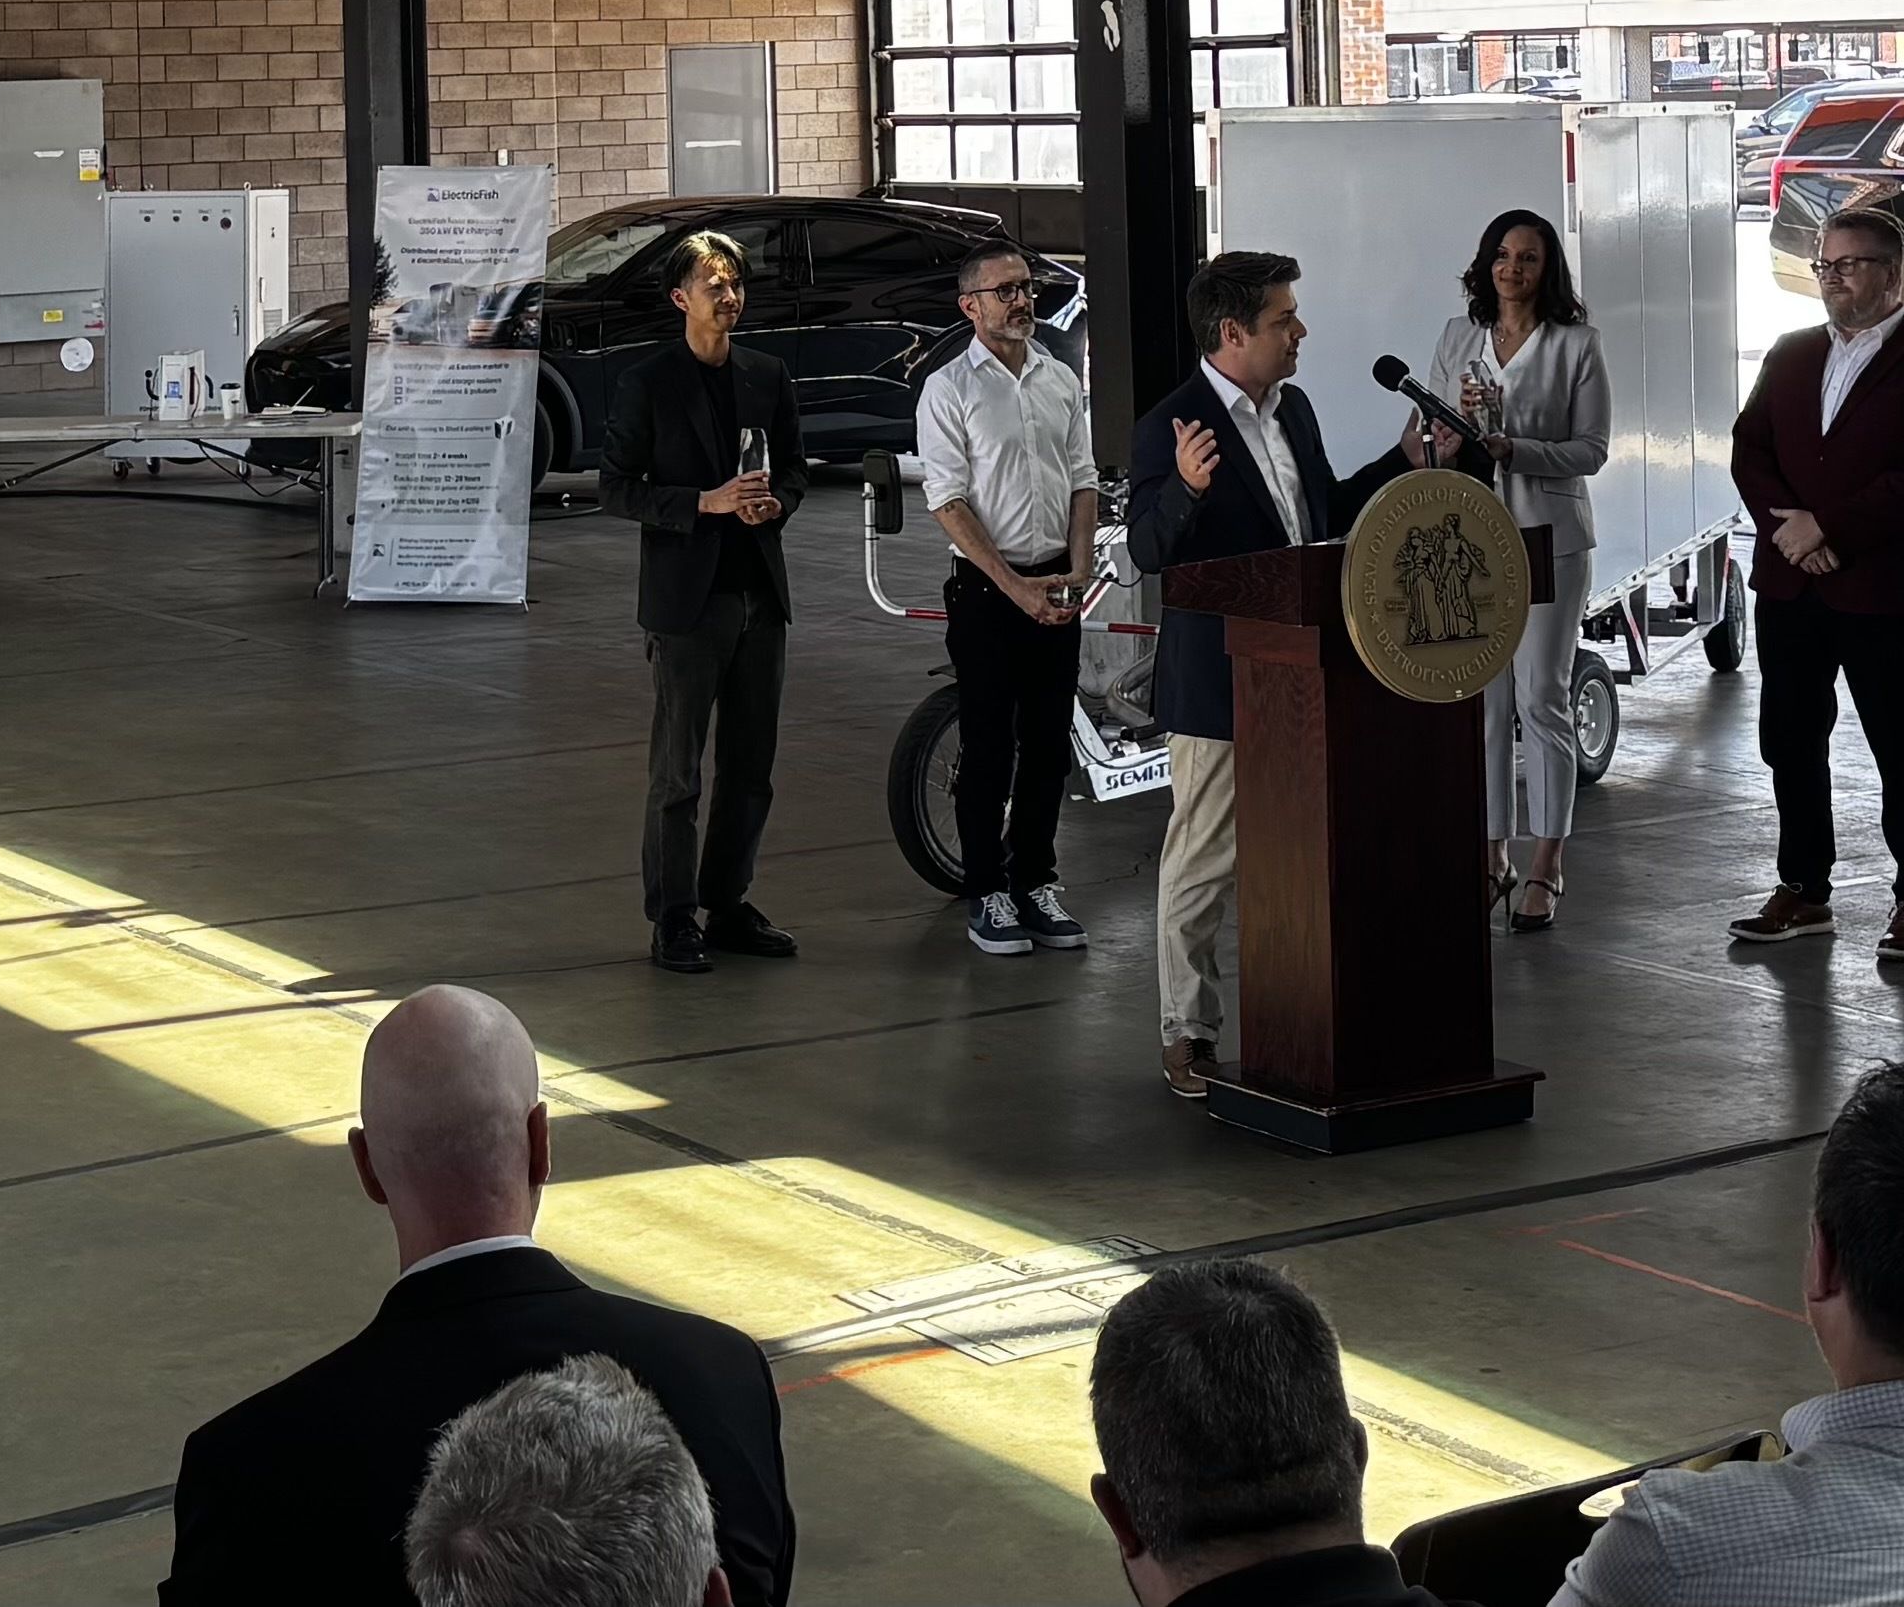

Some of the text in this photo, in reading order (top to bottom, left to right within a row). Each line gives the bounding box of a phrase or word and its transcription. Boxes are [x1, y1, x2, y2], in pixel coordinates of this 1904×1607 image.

[1364, 561, 1377, 606] SEAL
[1459, 489, 1490, 522] THE
[1377, 629, 1441, 683] DETROIT
